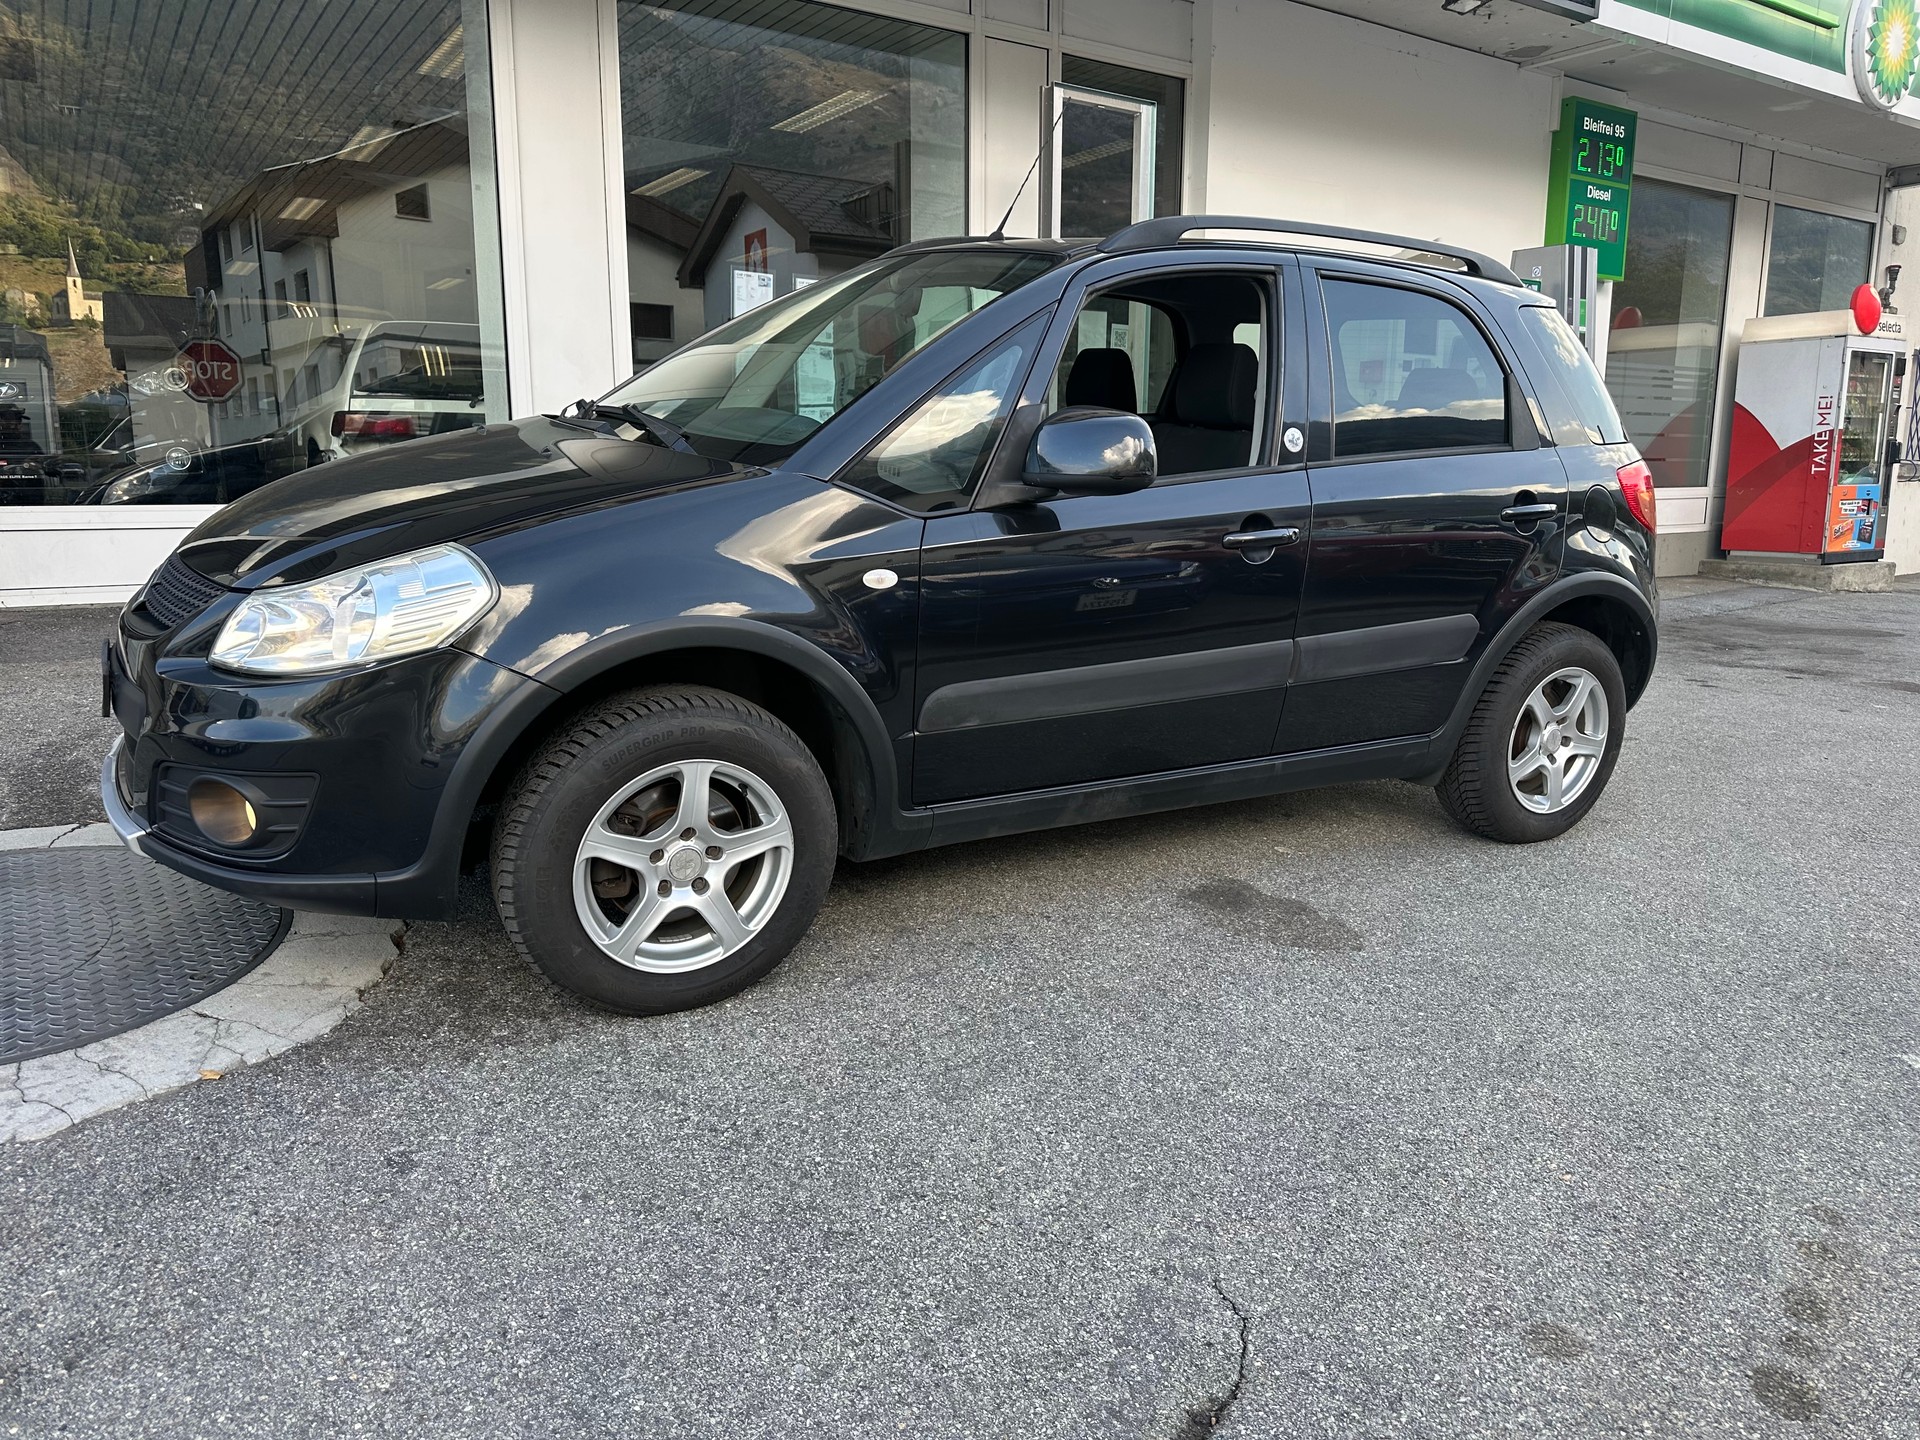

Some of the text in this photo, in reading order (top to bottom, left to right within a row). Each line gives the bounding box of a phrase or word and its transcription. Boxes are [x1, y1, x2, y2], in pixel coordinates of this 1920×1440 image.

[1583, 116, 1625, 139] Bleifrei 95
[1586, 185, 1612, 202] Diesel
[1878, 320, 1902, 334] selecta
[1811, 395, 1834, 474] TAKE ME!
[601, 726, 706, 771] SUPERGRIP PRO
